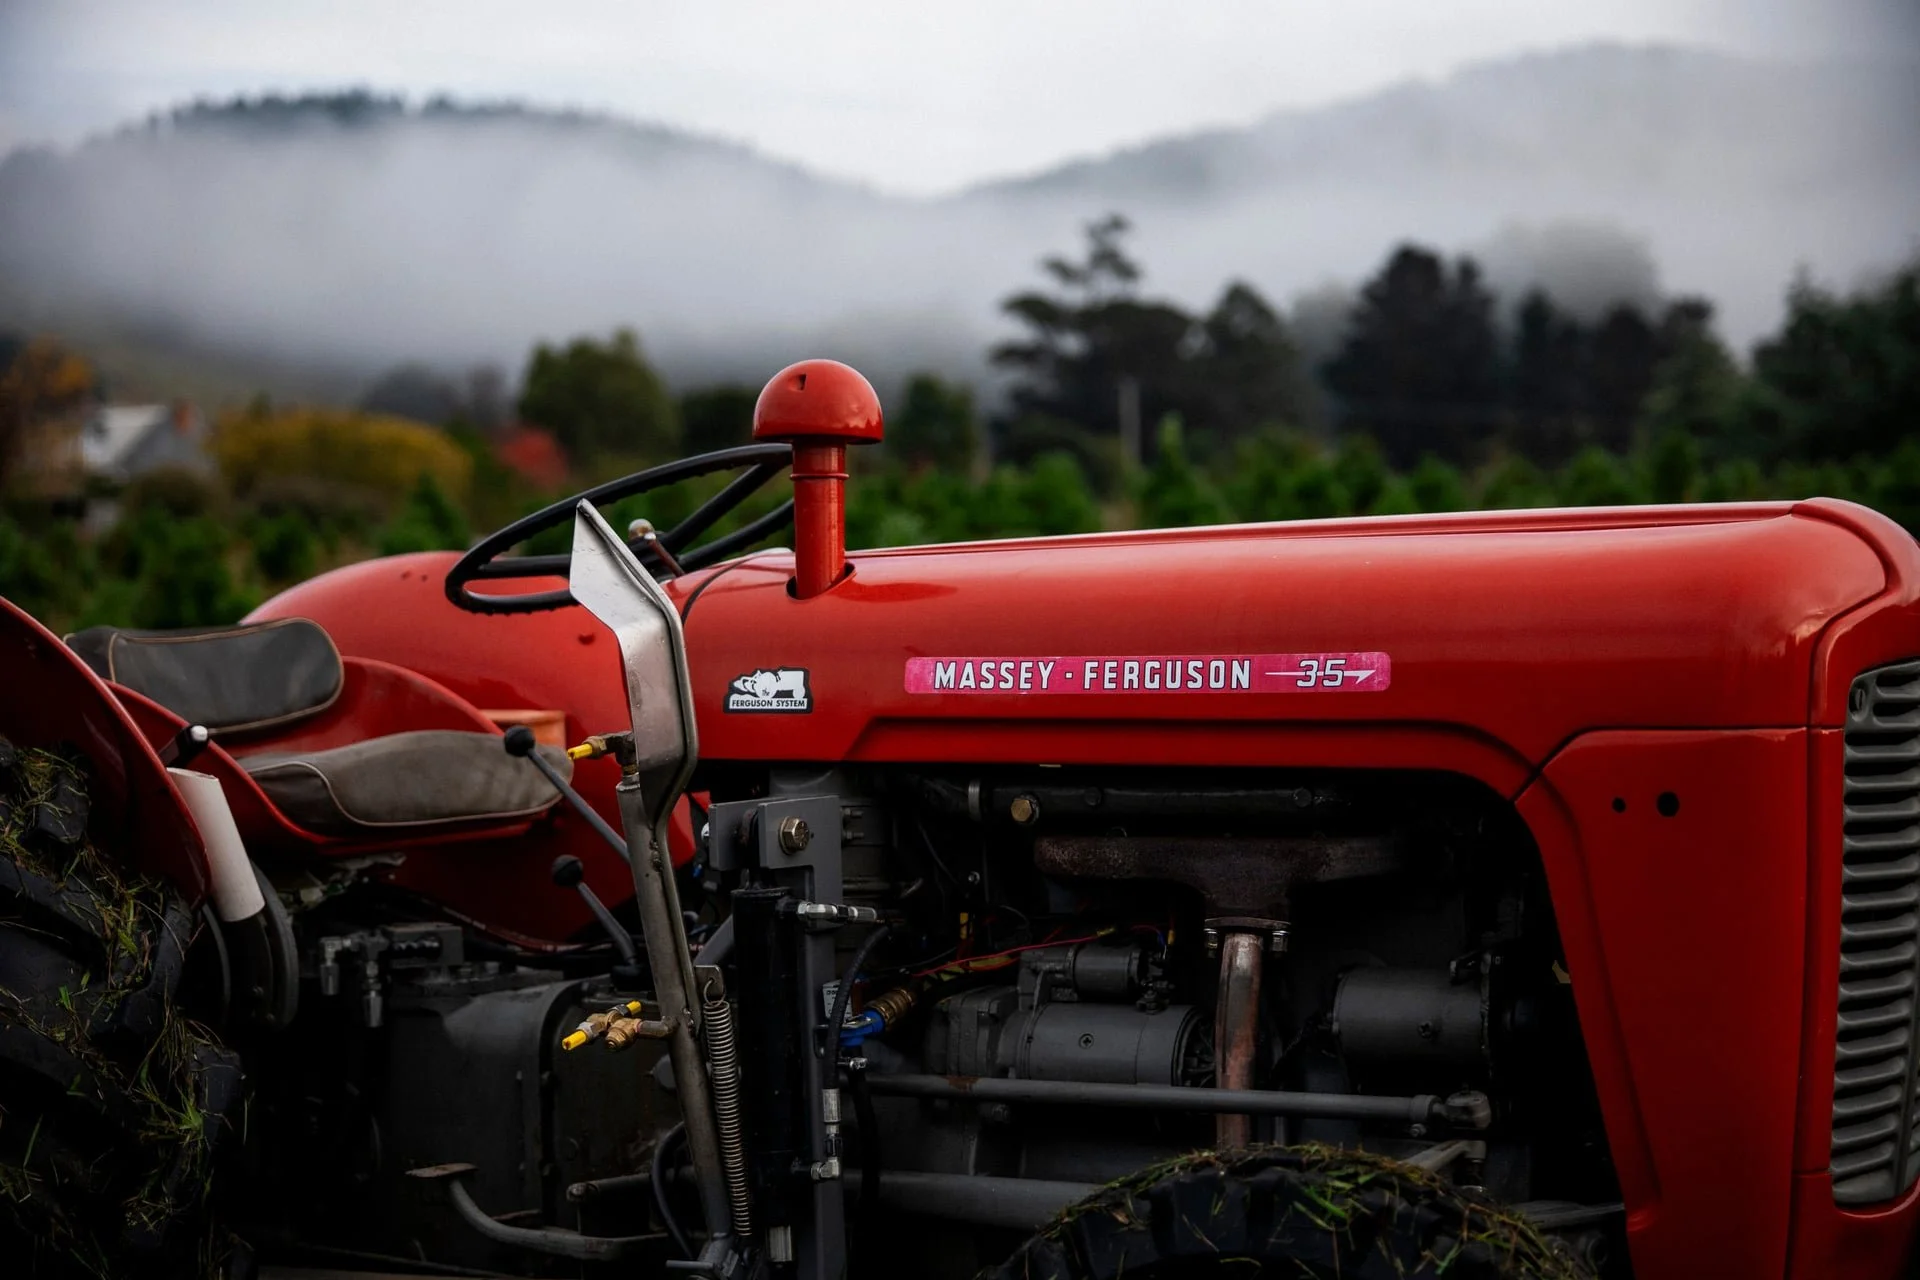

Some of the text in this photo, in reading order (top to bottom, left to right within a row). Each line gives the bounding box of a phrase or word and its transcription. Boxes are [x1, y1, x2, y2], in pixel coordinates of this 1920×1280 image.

[934, 659, 1347, 690] MASSEY FERGUSON 35
[732, 699, 805, 707] FERGUSON SYSTEM
